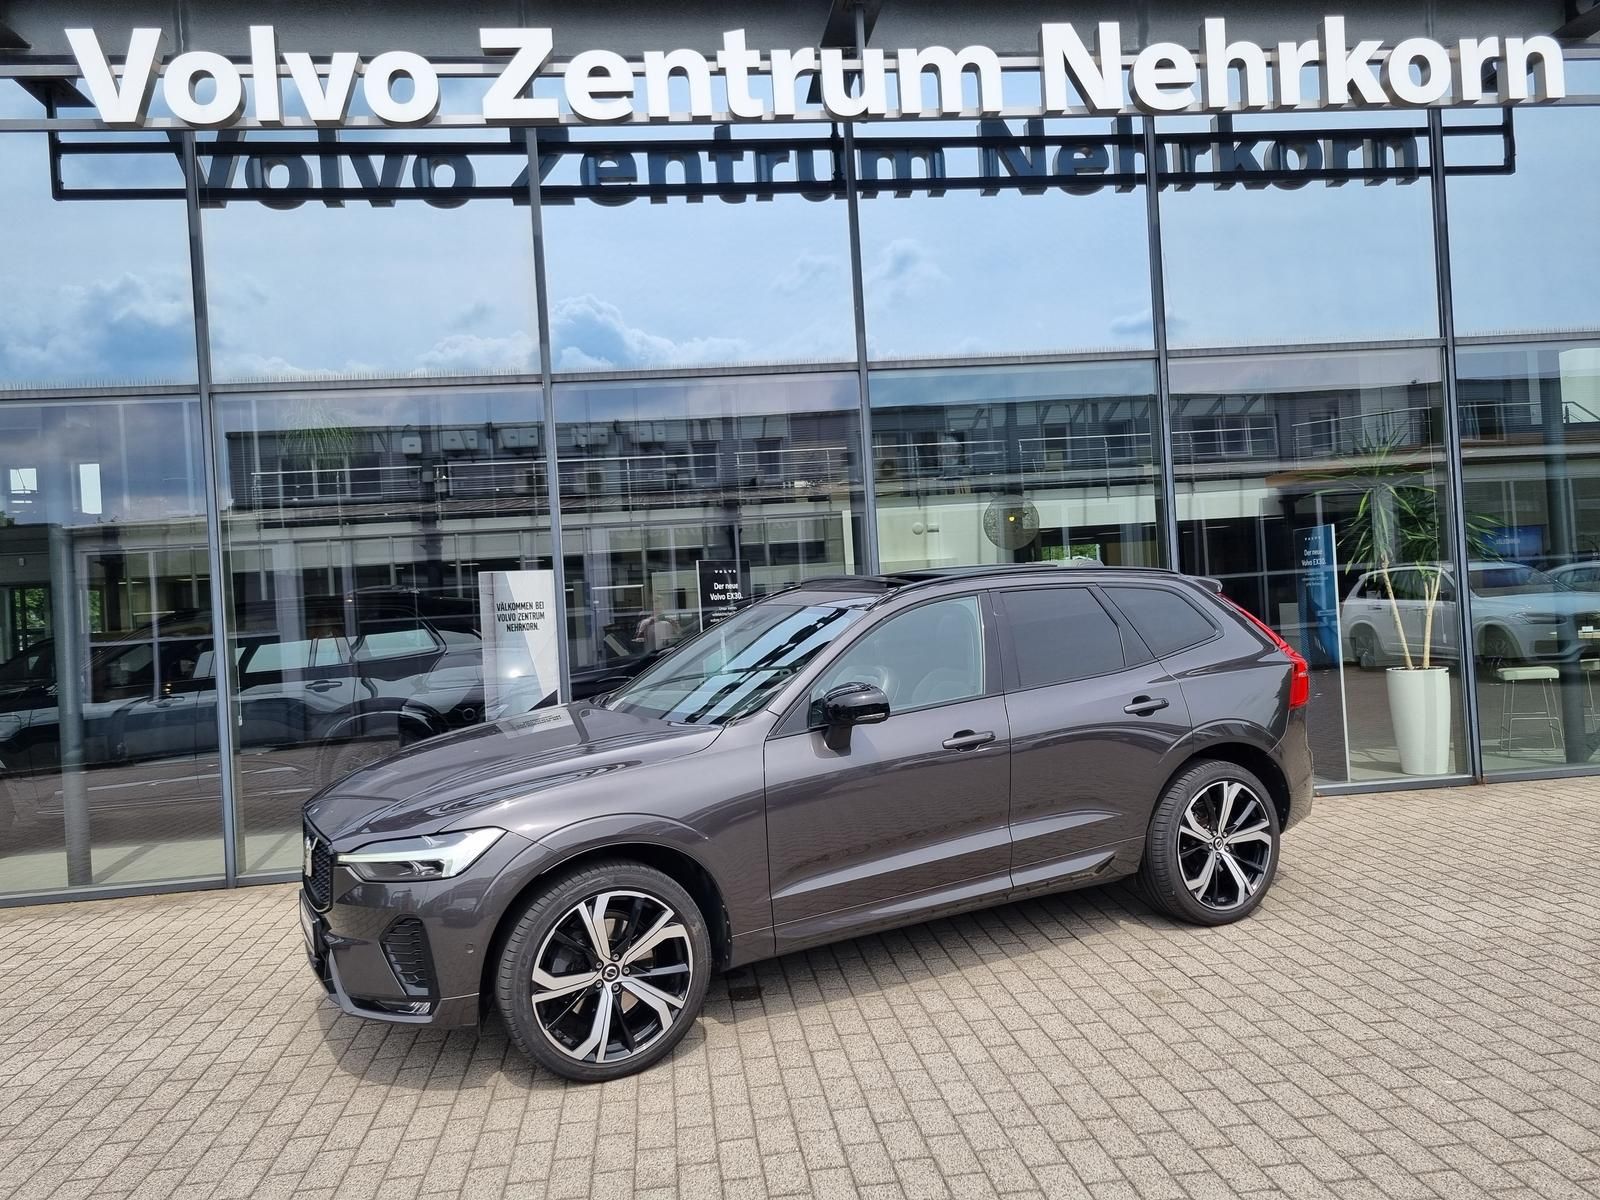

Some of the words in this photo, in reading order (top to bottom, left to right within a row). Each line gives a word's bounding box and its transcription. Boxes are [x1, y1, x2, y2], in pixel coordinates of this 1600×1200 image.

[65, 25, 441, 128] Volvo
[479, 27, 1002, 124] Zentrum
[1040, 15, 1566, 115] Nehrkorn
[713, 582, 724, 590] Der
[726, 592, 743, 600] EX30.
[496, 601, 533, 611] VÄLKOMMEN
[535, 601, 545, 610] BEI
[496, 612, 516, 622] VOLVO
[518, 612, 545, 620] ZENTRUM
[506, 622, 539, 632] NEHRKORN.
